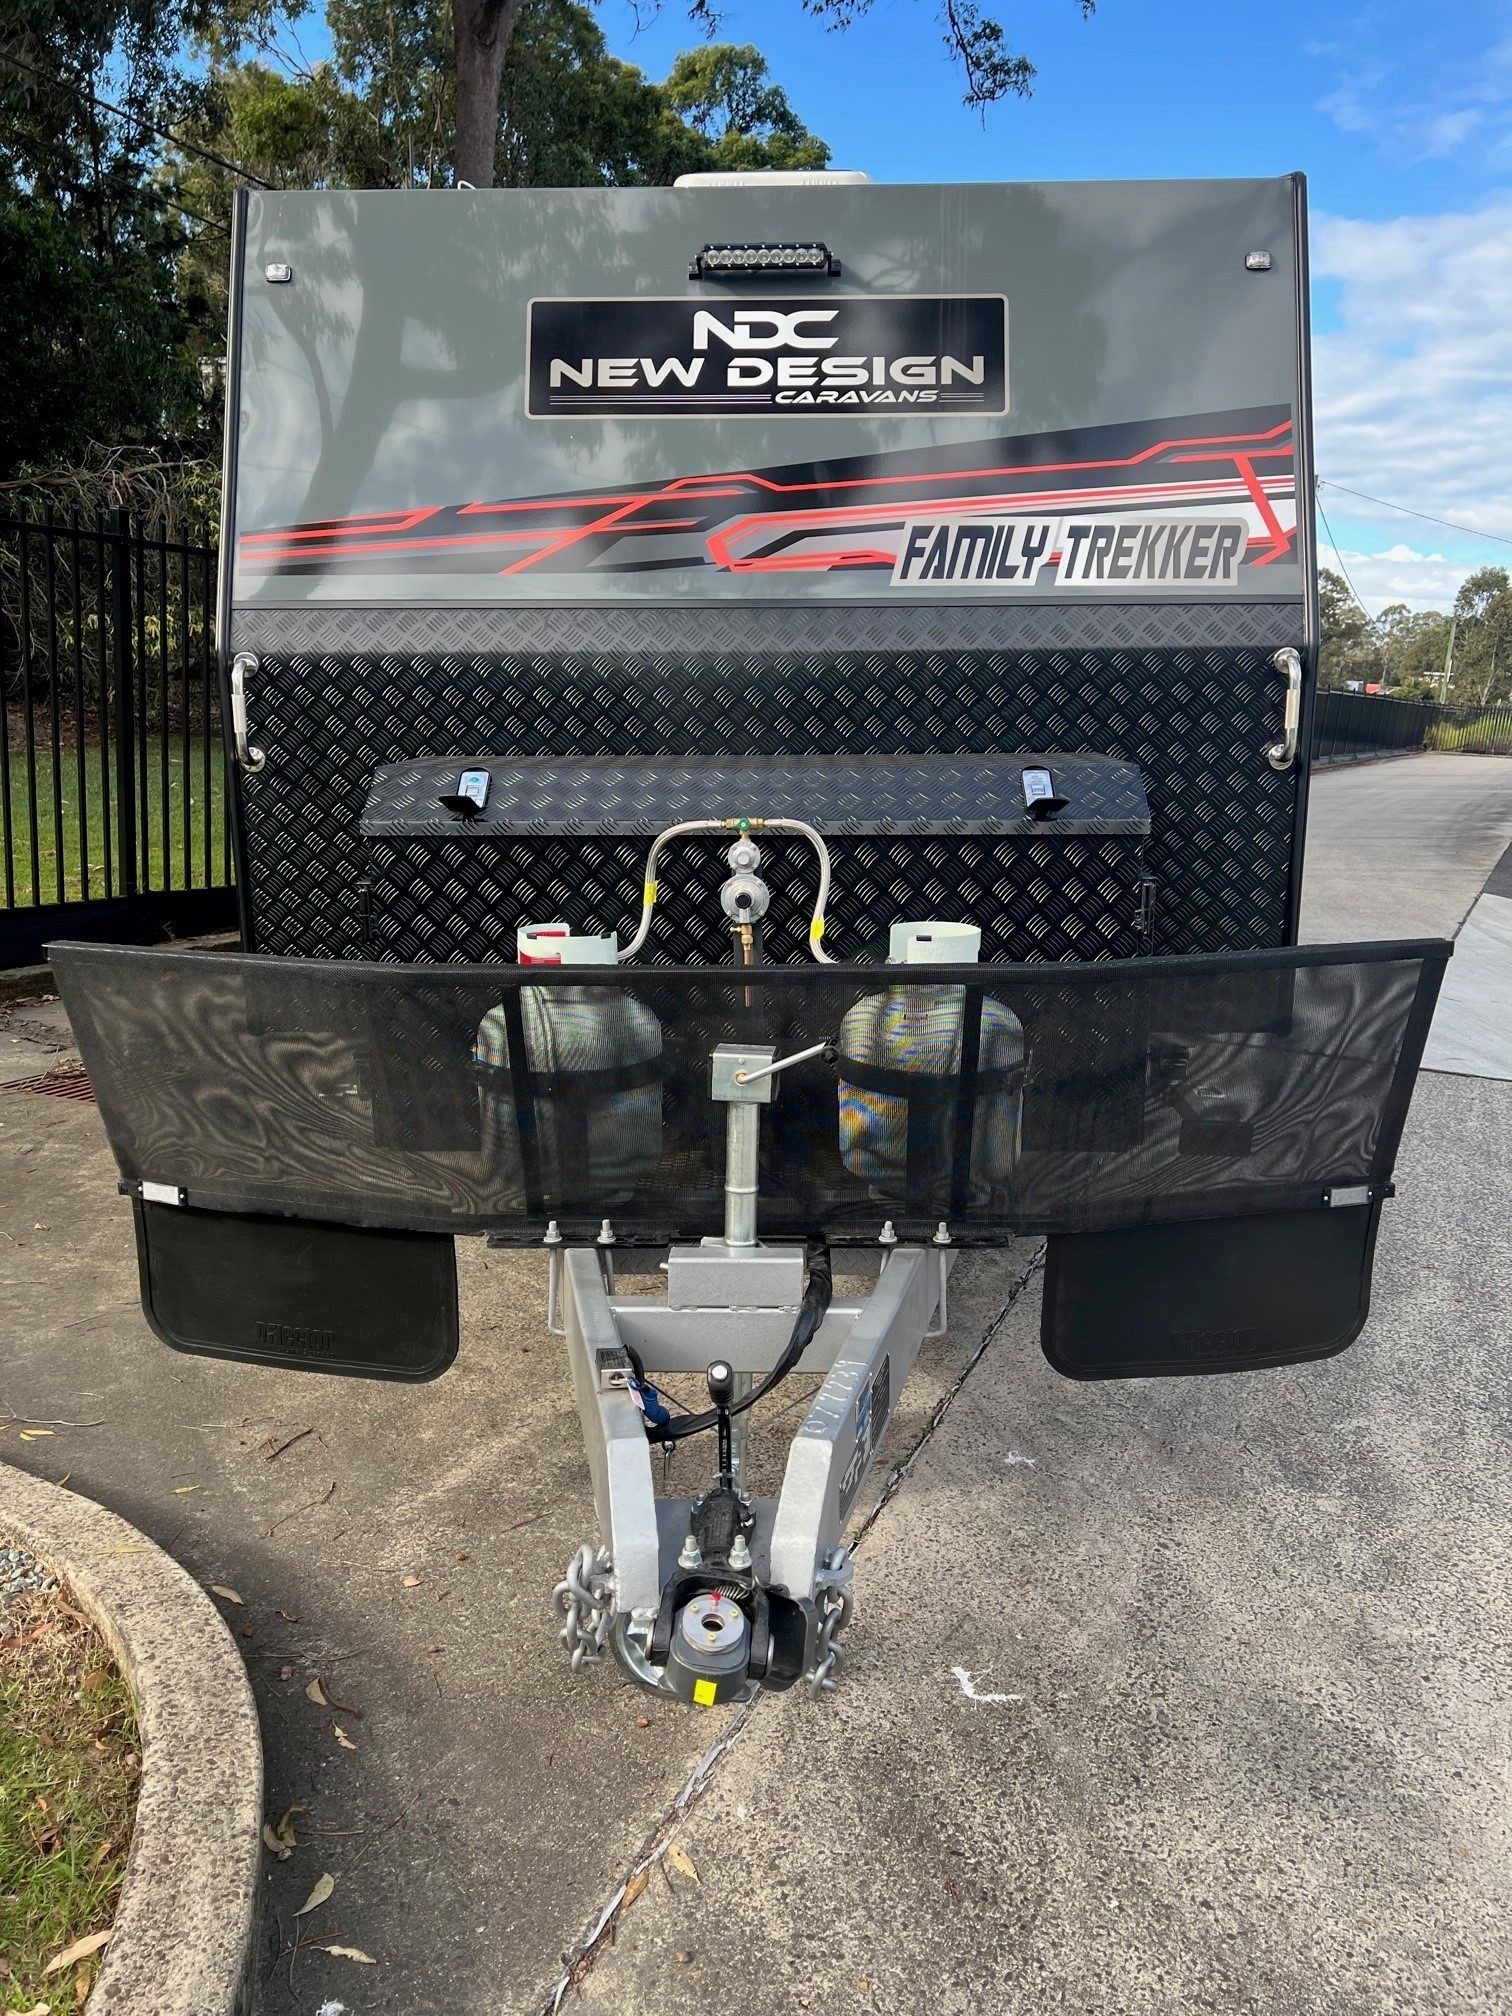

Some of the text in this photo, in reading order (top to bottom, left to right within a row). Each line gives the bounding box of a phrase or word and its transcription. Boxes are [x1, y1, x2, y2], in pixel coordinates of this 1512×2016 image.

[693, 310, 840, 350] NDC
[549, 355, 985, 388] NEW DESIGN
[774, 389, 940, 404] CARAVANS
[899, 524, 1243, 580] FAMILY TREKKER
